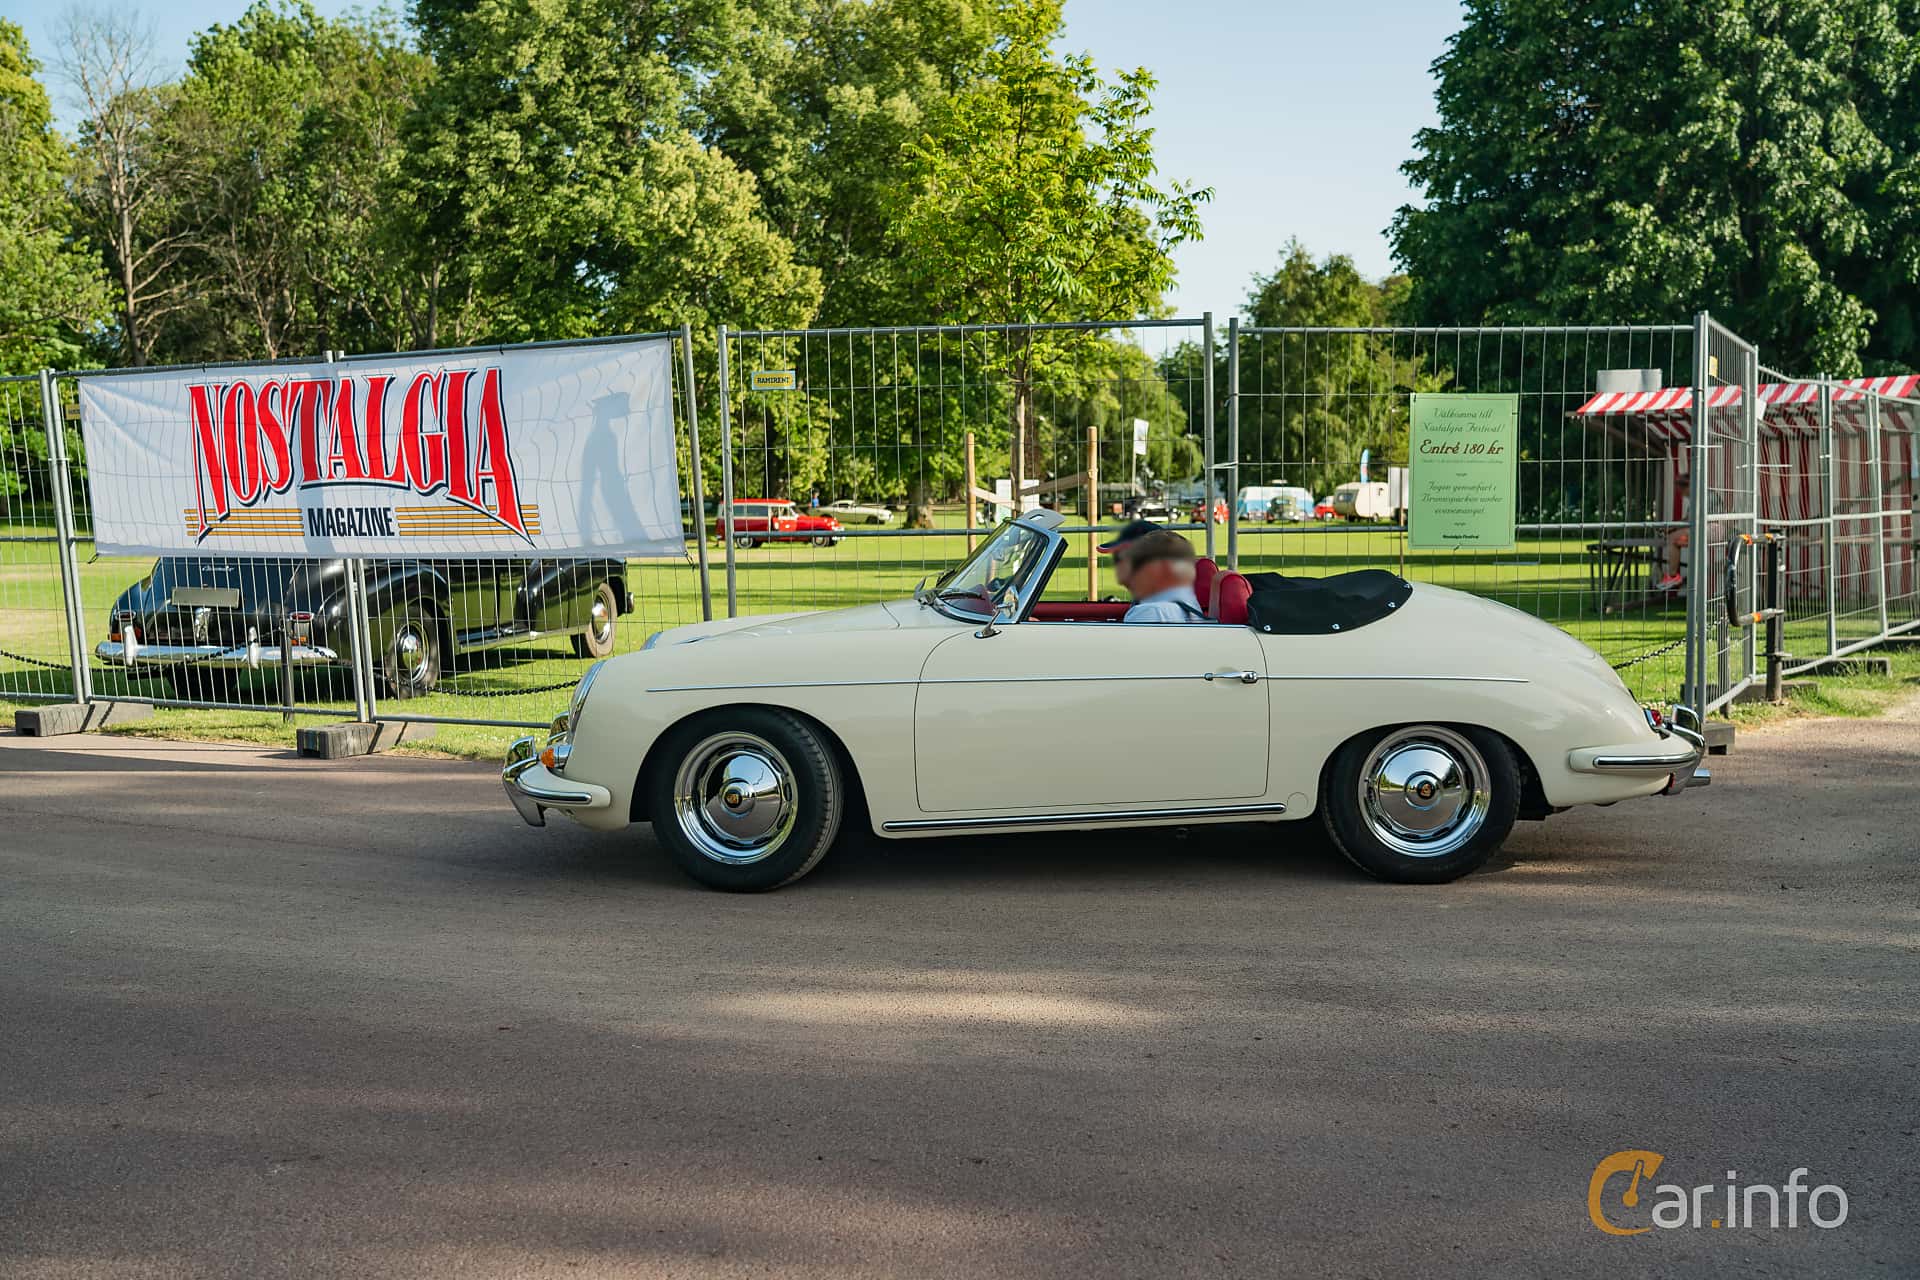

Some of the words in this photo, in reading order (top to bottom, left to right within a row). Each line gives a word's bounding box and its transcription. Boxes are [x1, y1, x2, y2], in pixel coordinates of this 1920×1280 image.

[757, 376, 789, 384] RAMIRENT
[1479, 408, 1493, 418] till
[1423, 422, 1463, 434] Nostalgia
[1420, 439, 1460, 454] Entré
[1463, 443, 1485, 454] 180
[1486, 440, 1504, 454] kr
[185, 366, 538, 547] NOSTALGIA
[307, 507, 396, 538] MAGAZINE
